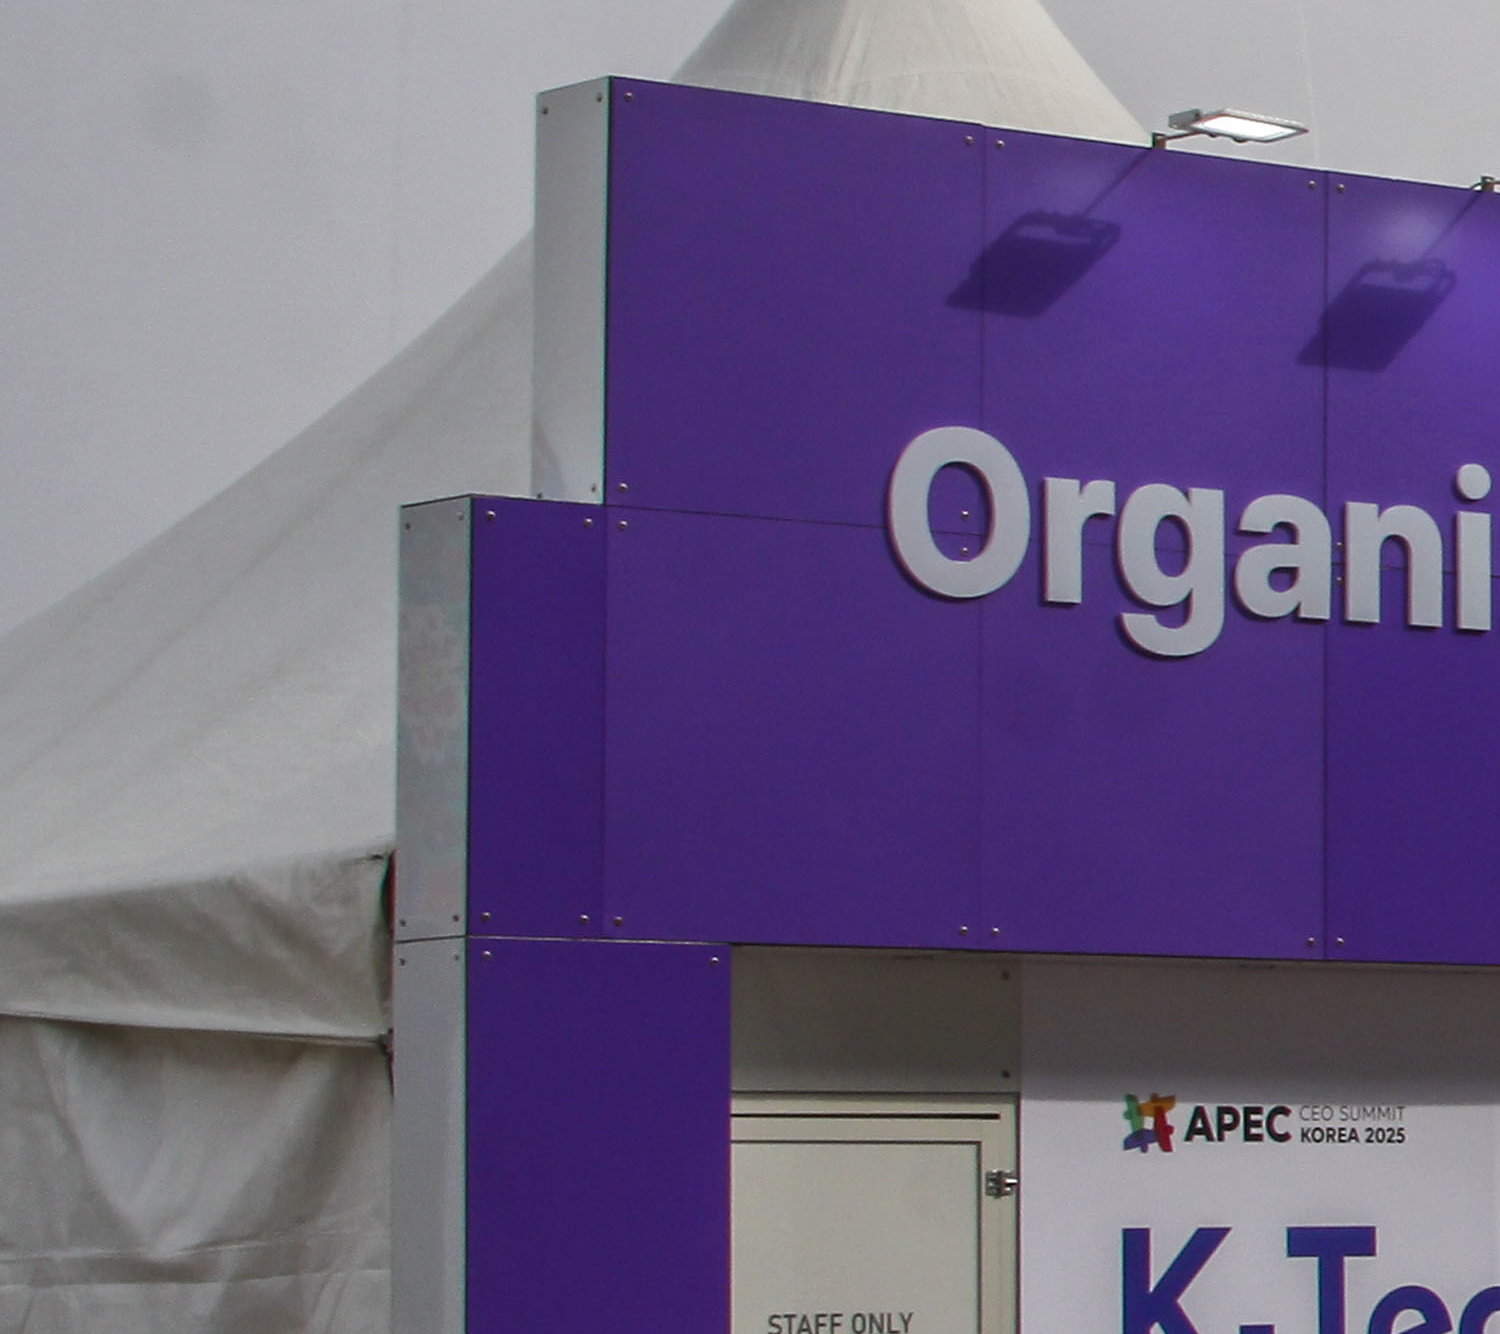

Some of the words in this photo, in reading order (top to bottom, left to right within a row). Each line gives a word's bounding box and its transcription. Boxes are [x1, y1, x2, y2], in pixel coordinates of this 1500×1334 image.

[1300, 1105, 1335, 1121] CEO
[1340, 1105, 1406, 1121] SUMMIT
[1183, 1105, 1292, 1143] APEC
[1301, 1127, 1360, 1144] KOREA
[1364, 1127, 1406, 1144] 2025
